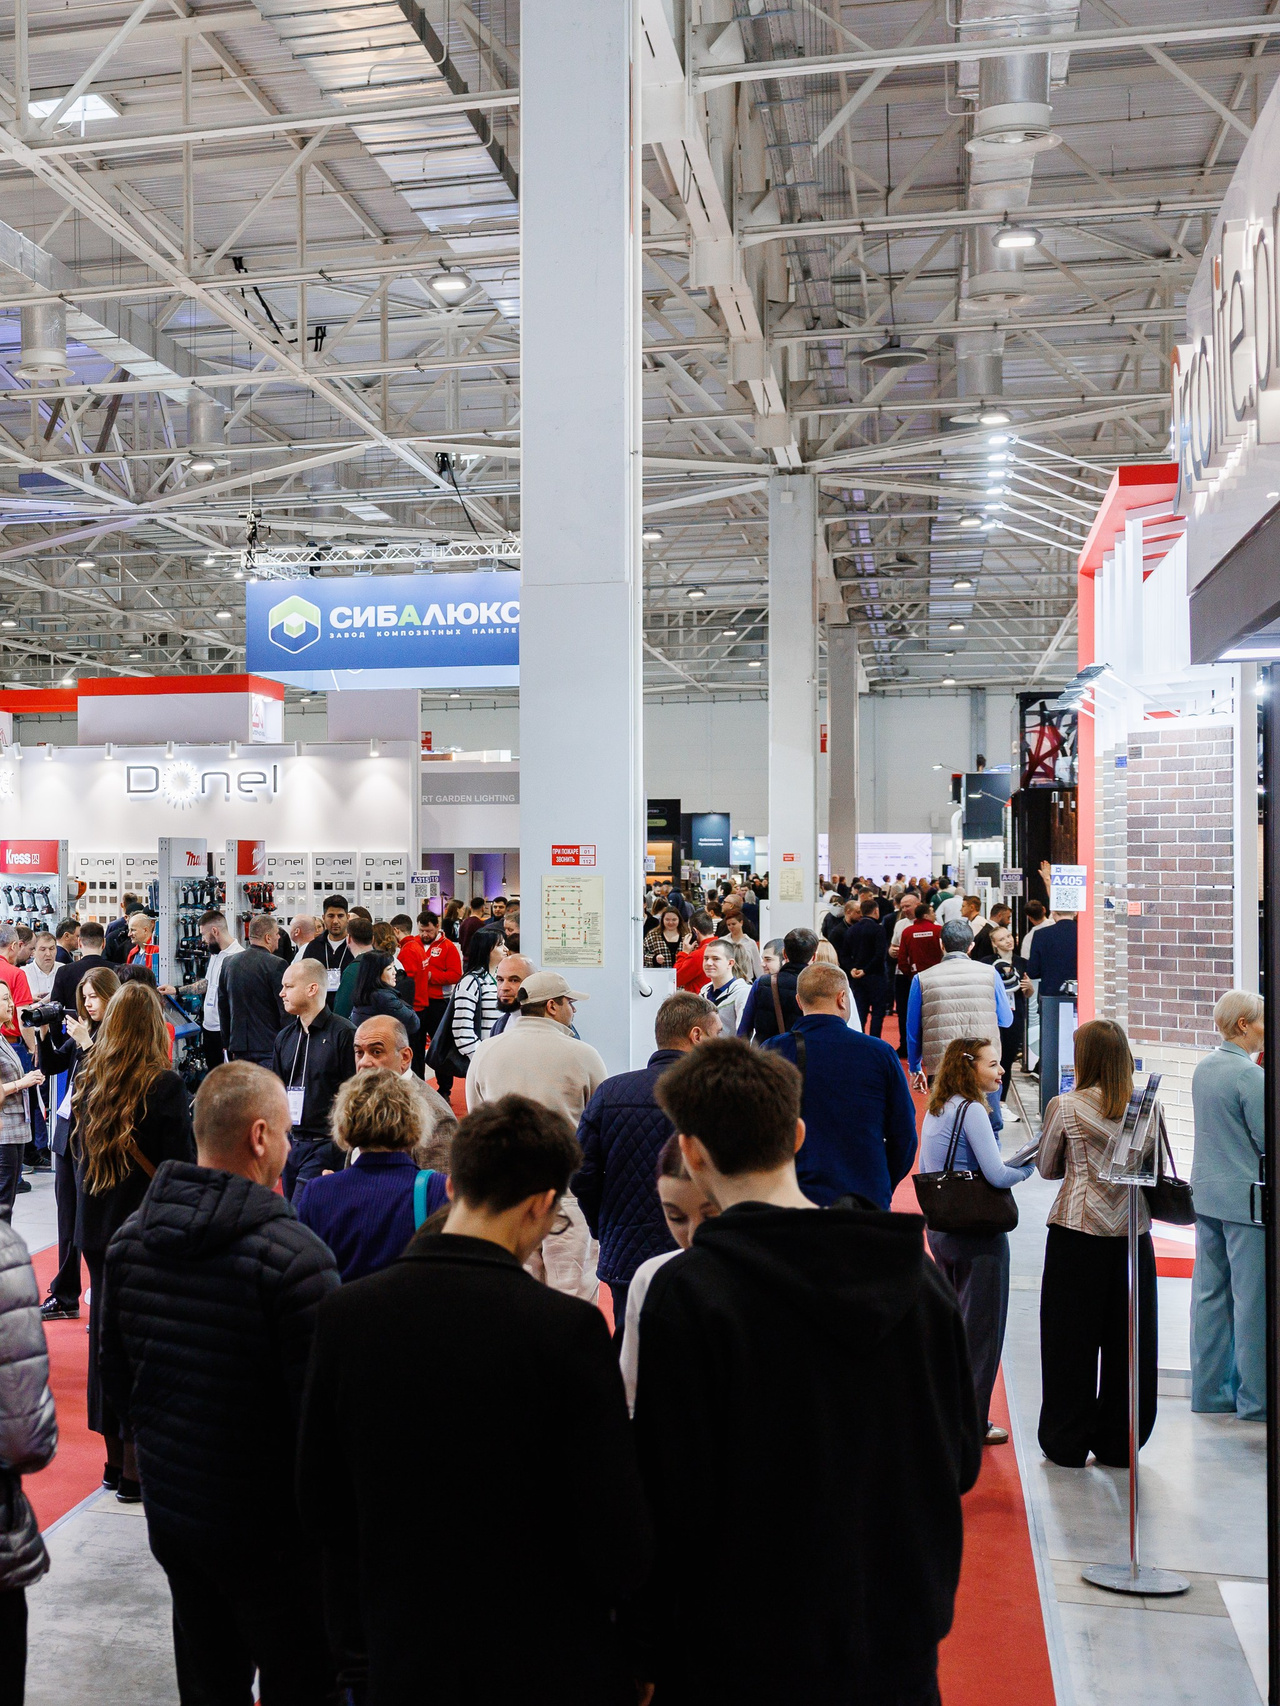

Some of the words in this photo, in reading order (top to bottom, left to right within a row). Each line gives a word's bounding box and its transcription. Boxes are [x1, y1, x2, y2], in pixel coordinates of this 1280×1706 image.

[329, 601, 520, 629] СИБАЛЮКС
[329, 631, 366, 639] ЗАВОД
[376, 628, 461, 637] КОМПОЗИТНЫХ
[472, 627, 518, 635] ПАНЕЛЕ
[422, 795, 434, 803] RT
[435, 794, 472, 803] GARDEN
[474, 794, 516, 802] LIGHTING
[5, 848, 31, 865] Kress
[126, 858, 158, 866] Done
[1052, 875, 1083, 886] A405
